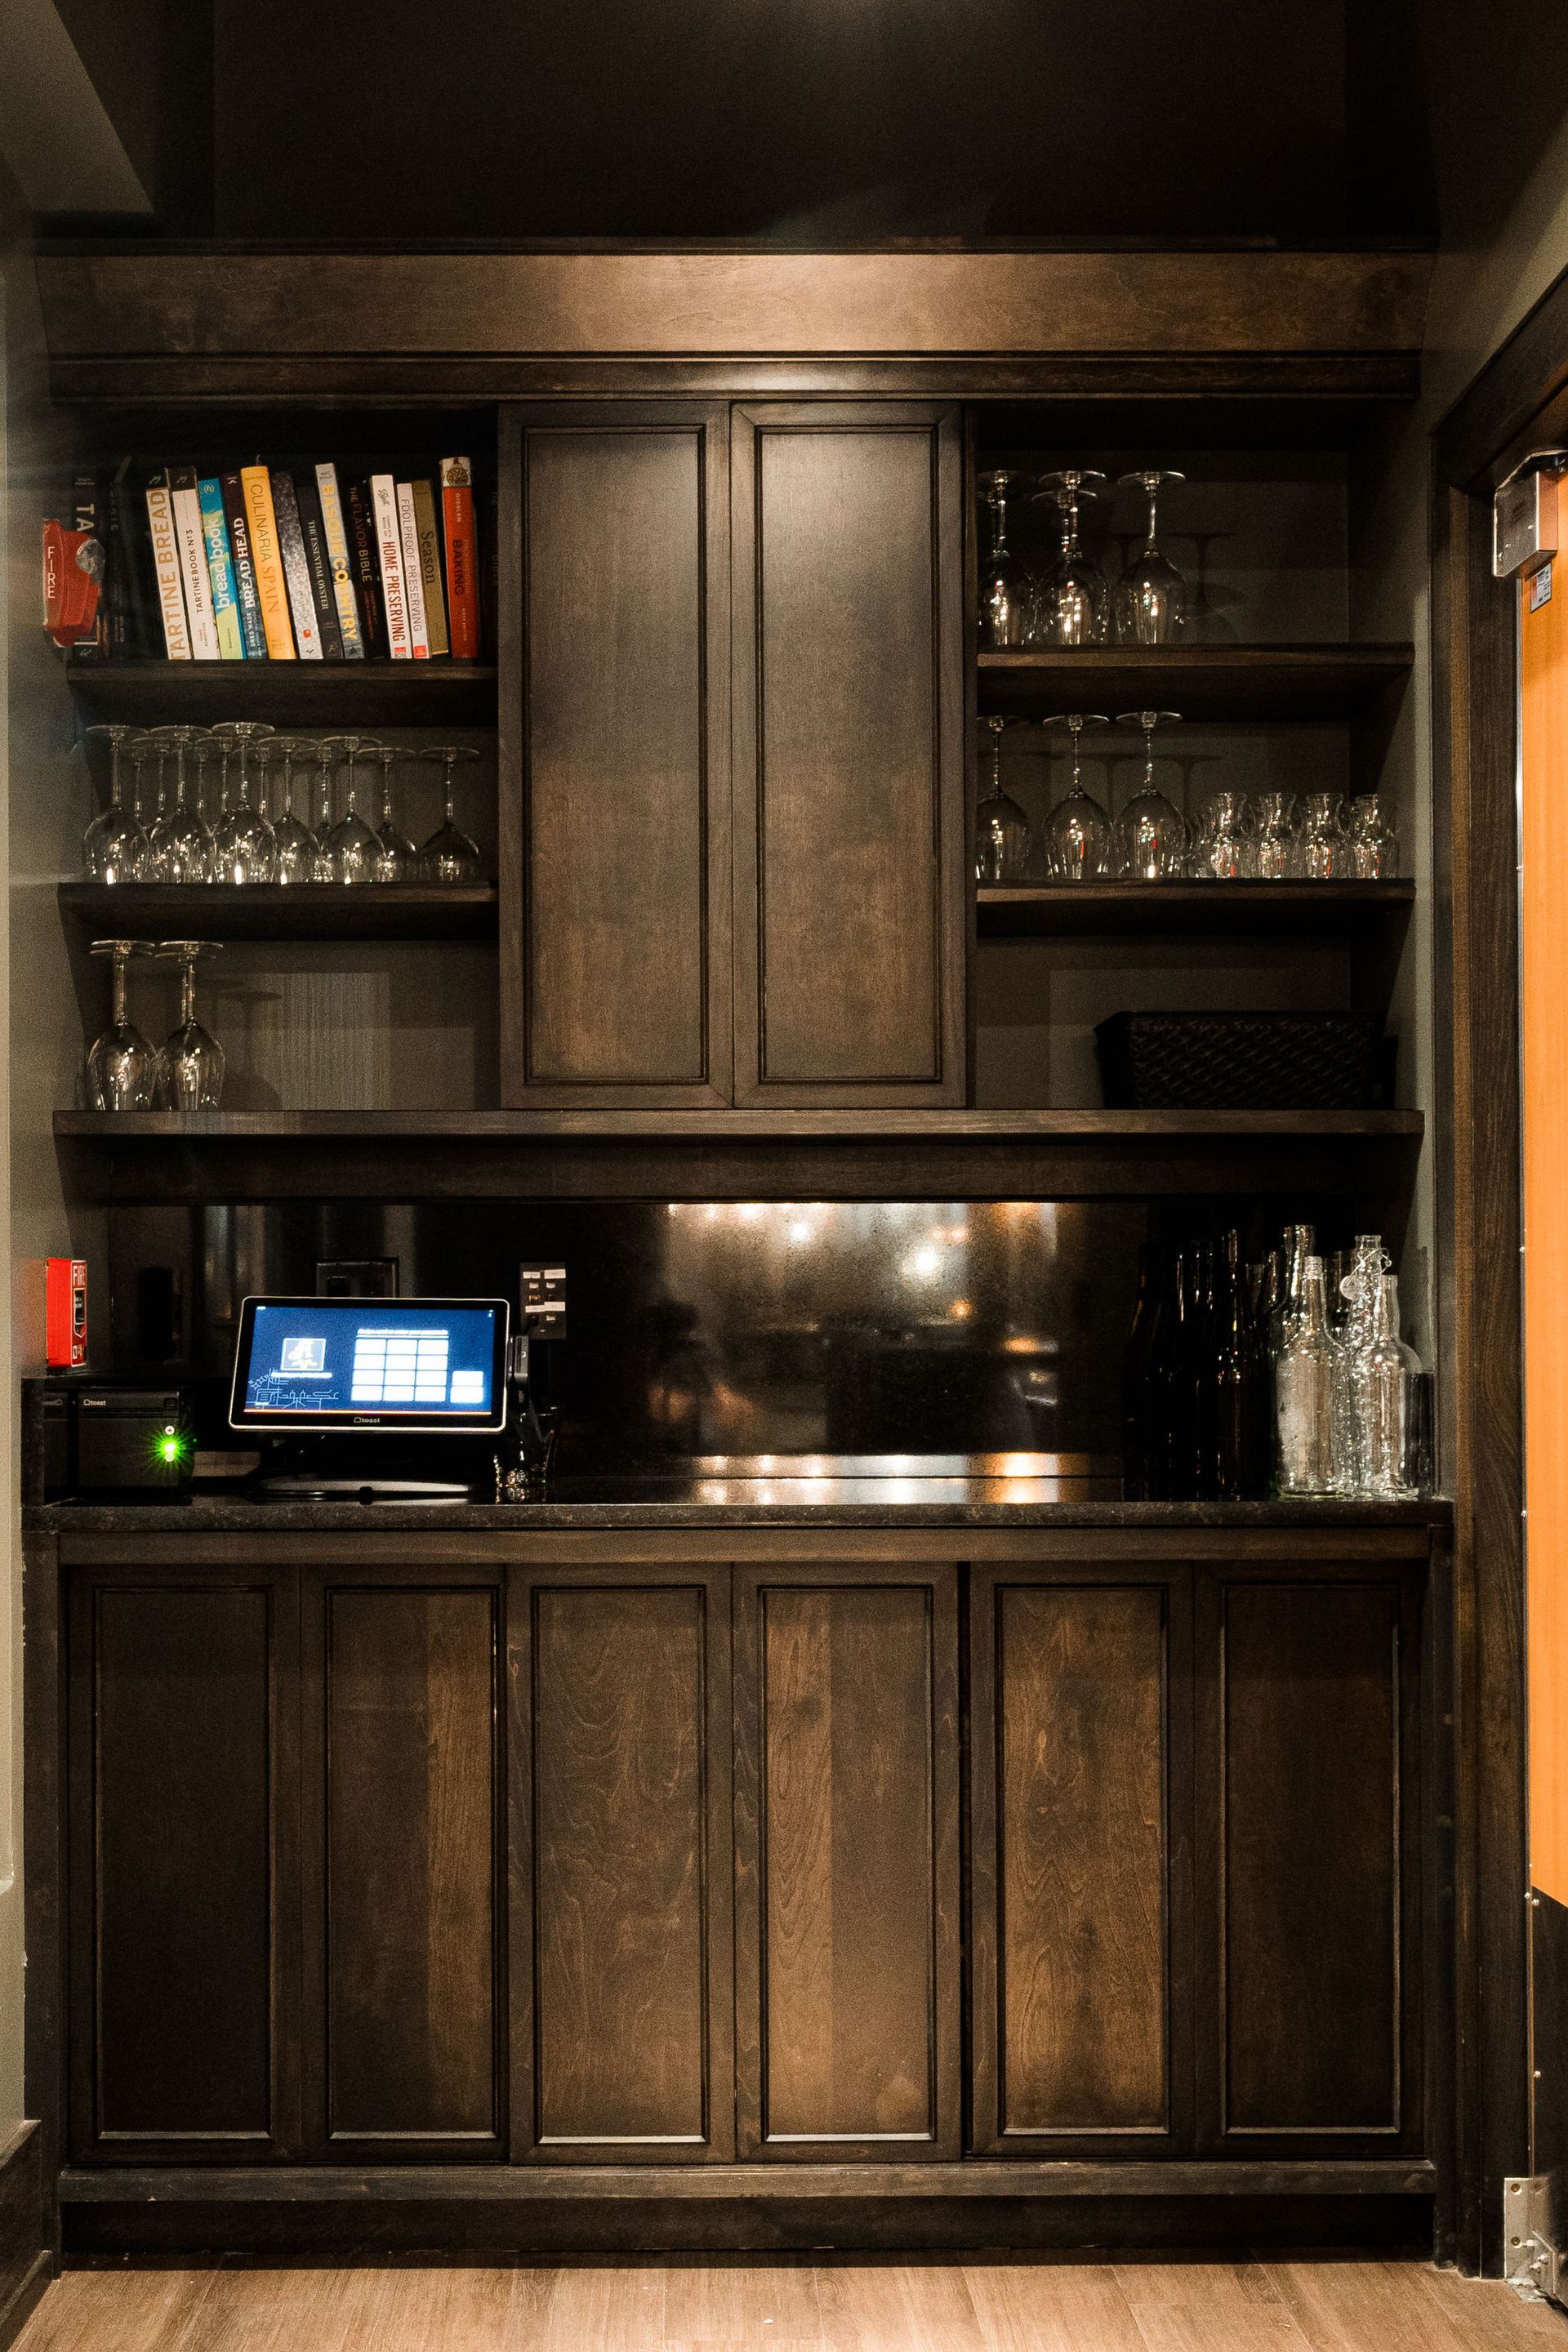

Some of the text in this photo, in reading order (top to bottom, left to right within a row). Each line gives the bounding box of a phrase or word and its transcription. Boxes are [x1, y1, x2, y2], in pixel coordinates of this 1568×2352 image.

[250, 483, 270, 562] CULINARIA
[261, 565, 280, 613] SPAIN
[322, 483, 344, 555] BASQUE
[349, 487, 358, 502] THE
[358, 549, 372, 582] BIBLE
[400, 498, 416, 561] FOOLPROOF
[47, 546, 56, 599] FIRE
[149, 491, 187, 659] TARTINE BREAD
[188, 549, 200, 575] BOOK
[205, 517, 230, 609] bread book
[234, 517, 255, 608] BREAD HEAD
[308, 520, 330, 610] THE ESSENTIAL OYSTER
[383, 541, 399, 572] HOME
[420, 531, 437, 585] Season
[452, 539, 465, 595] BAKING
[191, 576, 204, 613] TARTINE
[332, 556, 358, 641] COUNTRY
[385, 575, 406, 642] PRESERVING
[407, 564, 422, 632] PRESERVING
[73, 1265, 86, 1287] FIRE
